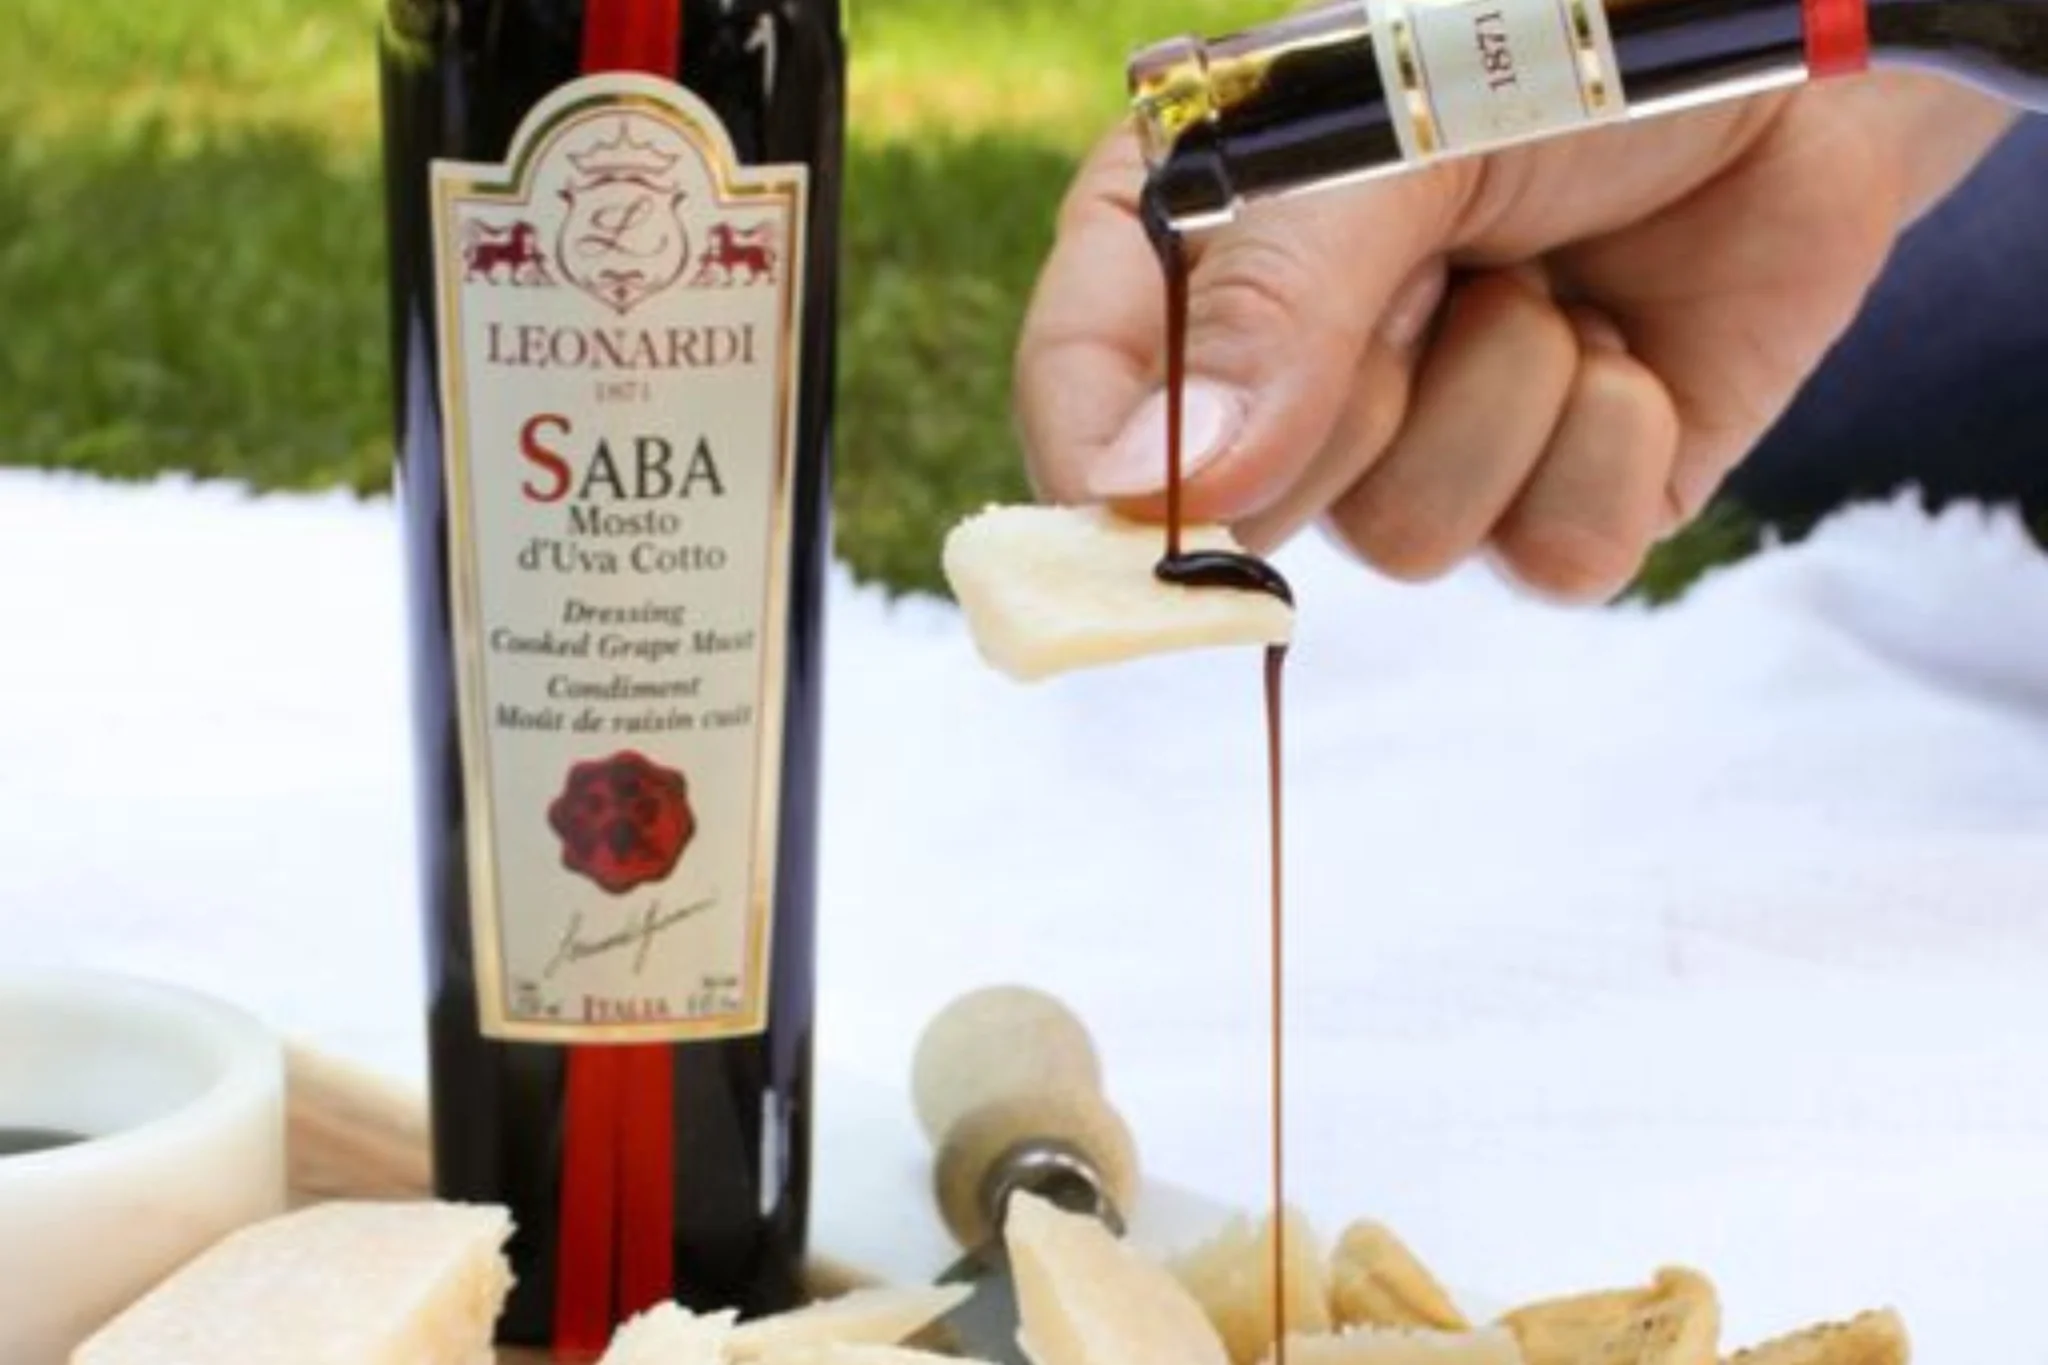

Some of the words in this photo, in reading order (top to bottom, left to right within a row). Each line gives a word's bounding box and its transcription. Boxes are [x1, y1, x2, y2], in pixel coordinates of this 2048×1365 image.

[486, 321, 757, 369] LEONARDI
[567, 505, 681, 537] Mosto
[516, 536, 619, 575] d'Uva
[629, 541, 728, 575] Cotto
[562, 598, 686, 628] Dressing
[490, 627, 591, 658] Cooked
[597, 632, 682, 663] Grape
[692, 628, 755, 654] Must
[546, 674, 703, 700] Condiment
[571, 708, 604, 733] de
[610, 706, 694, 734] raisin
